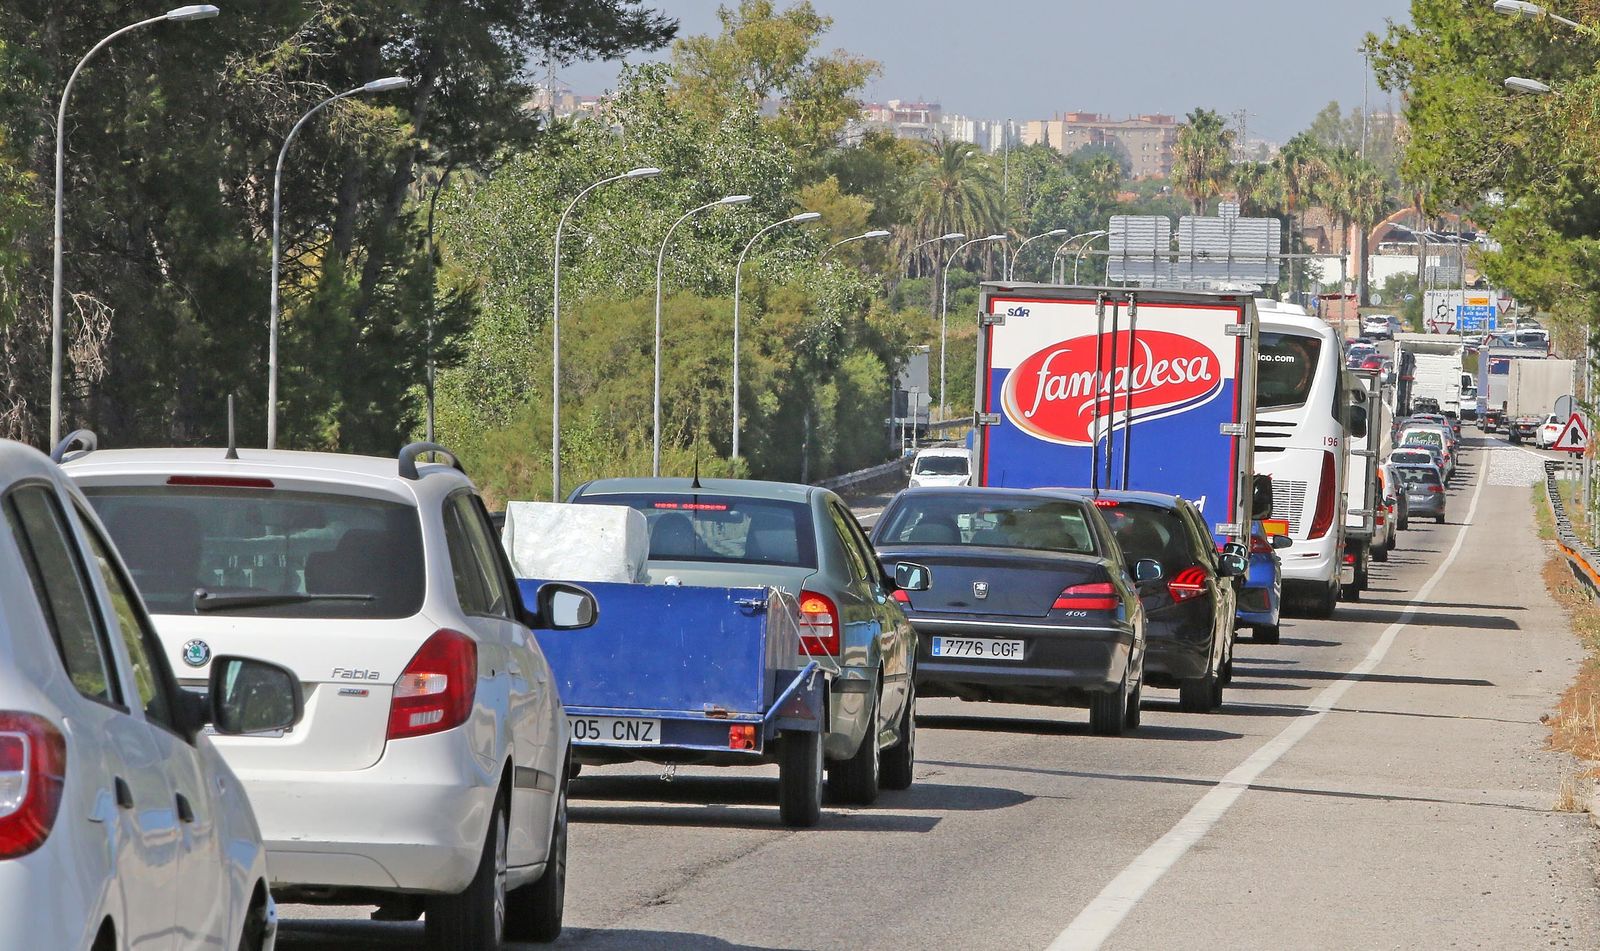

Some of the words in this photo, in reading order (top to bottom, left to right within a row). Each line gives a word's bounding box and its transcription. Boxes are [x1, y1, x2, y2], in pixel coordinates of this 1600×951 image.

[1024, 338, 1212, 418] famadesa
[1323, 436, 1338, 447] 196
[1065, 610, 1087, 618] 406
[945, 640, 983, 655] 7776
[991, 642, 1020, 657] CGF
[568, 719, 600, 740] 05
[612, 721, 654, 742] CNZ
